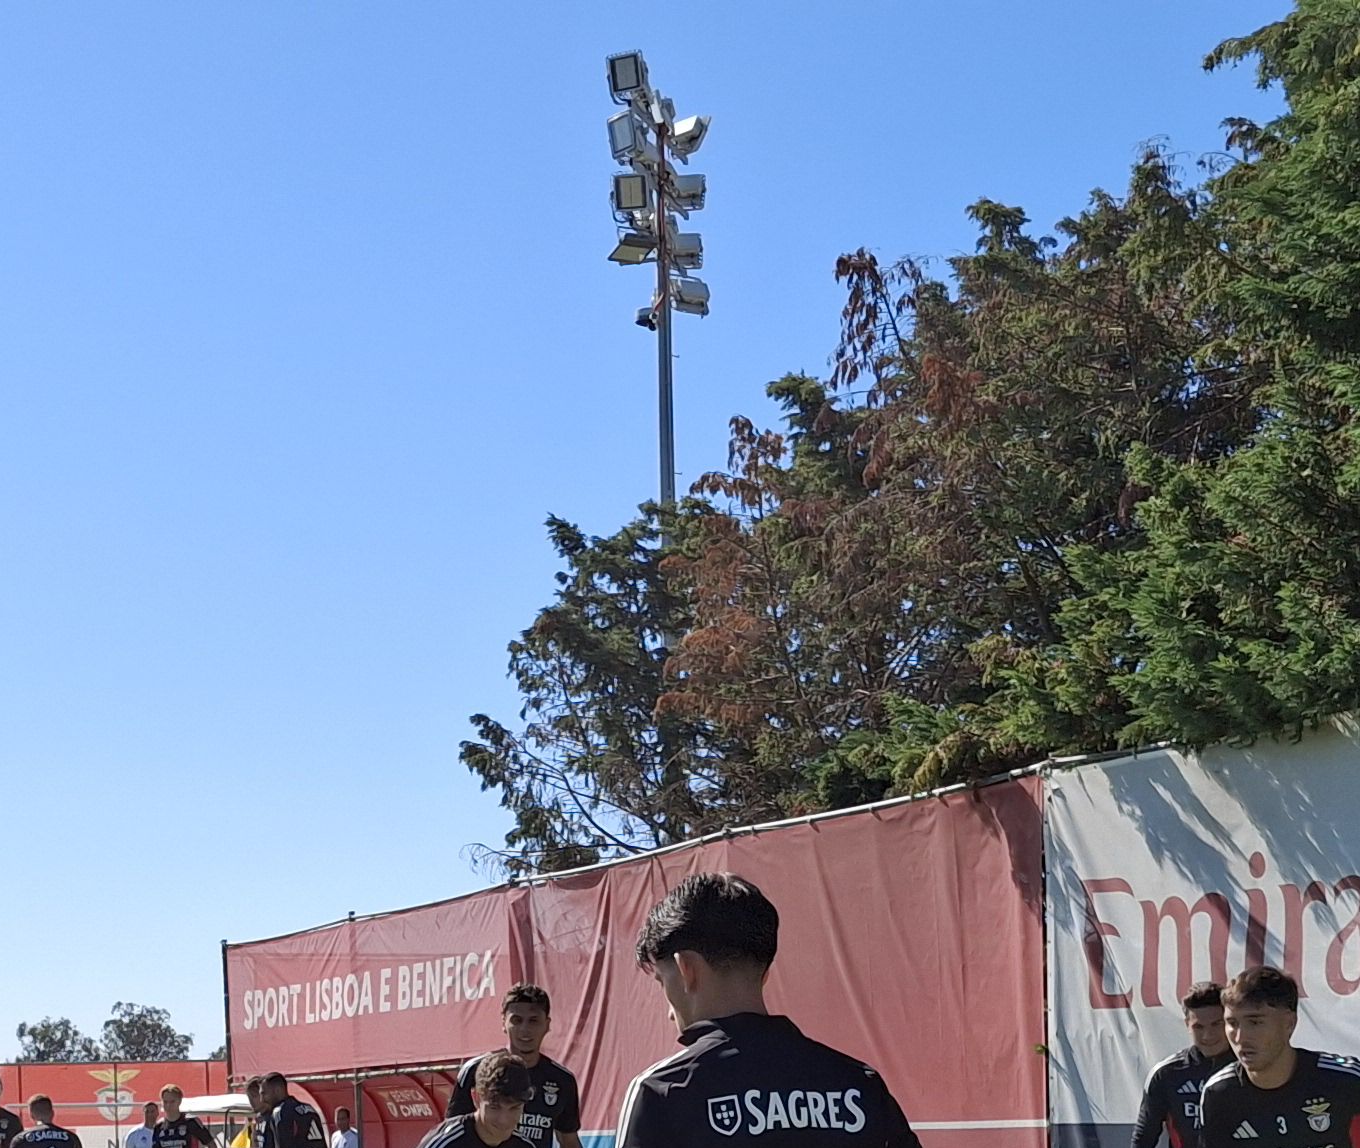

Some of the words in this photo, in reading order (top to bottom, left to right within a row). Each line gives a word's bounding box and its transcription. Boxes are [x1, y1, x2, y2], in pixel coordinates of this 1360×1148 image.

[243, 983, 302, 1031] SPORT
[305, 971, 374, 1024] LISBOA
[379, 967, 391, 1013] E
[397, 949, 496, 1011] BENFICA
[744, 1088, 866, 1135] SAGRES
[1276, 1116, 1288, 1135] 3
